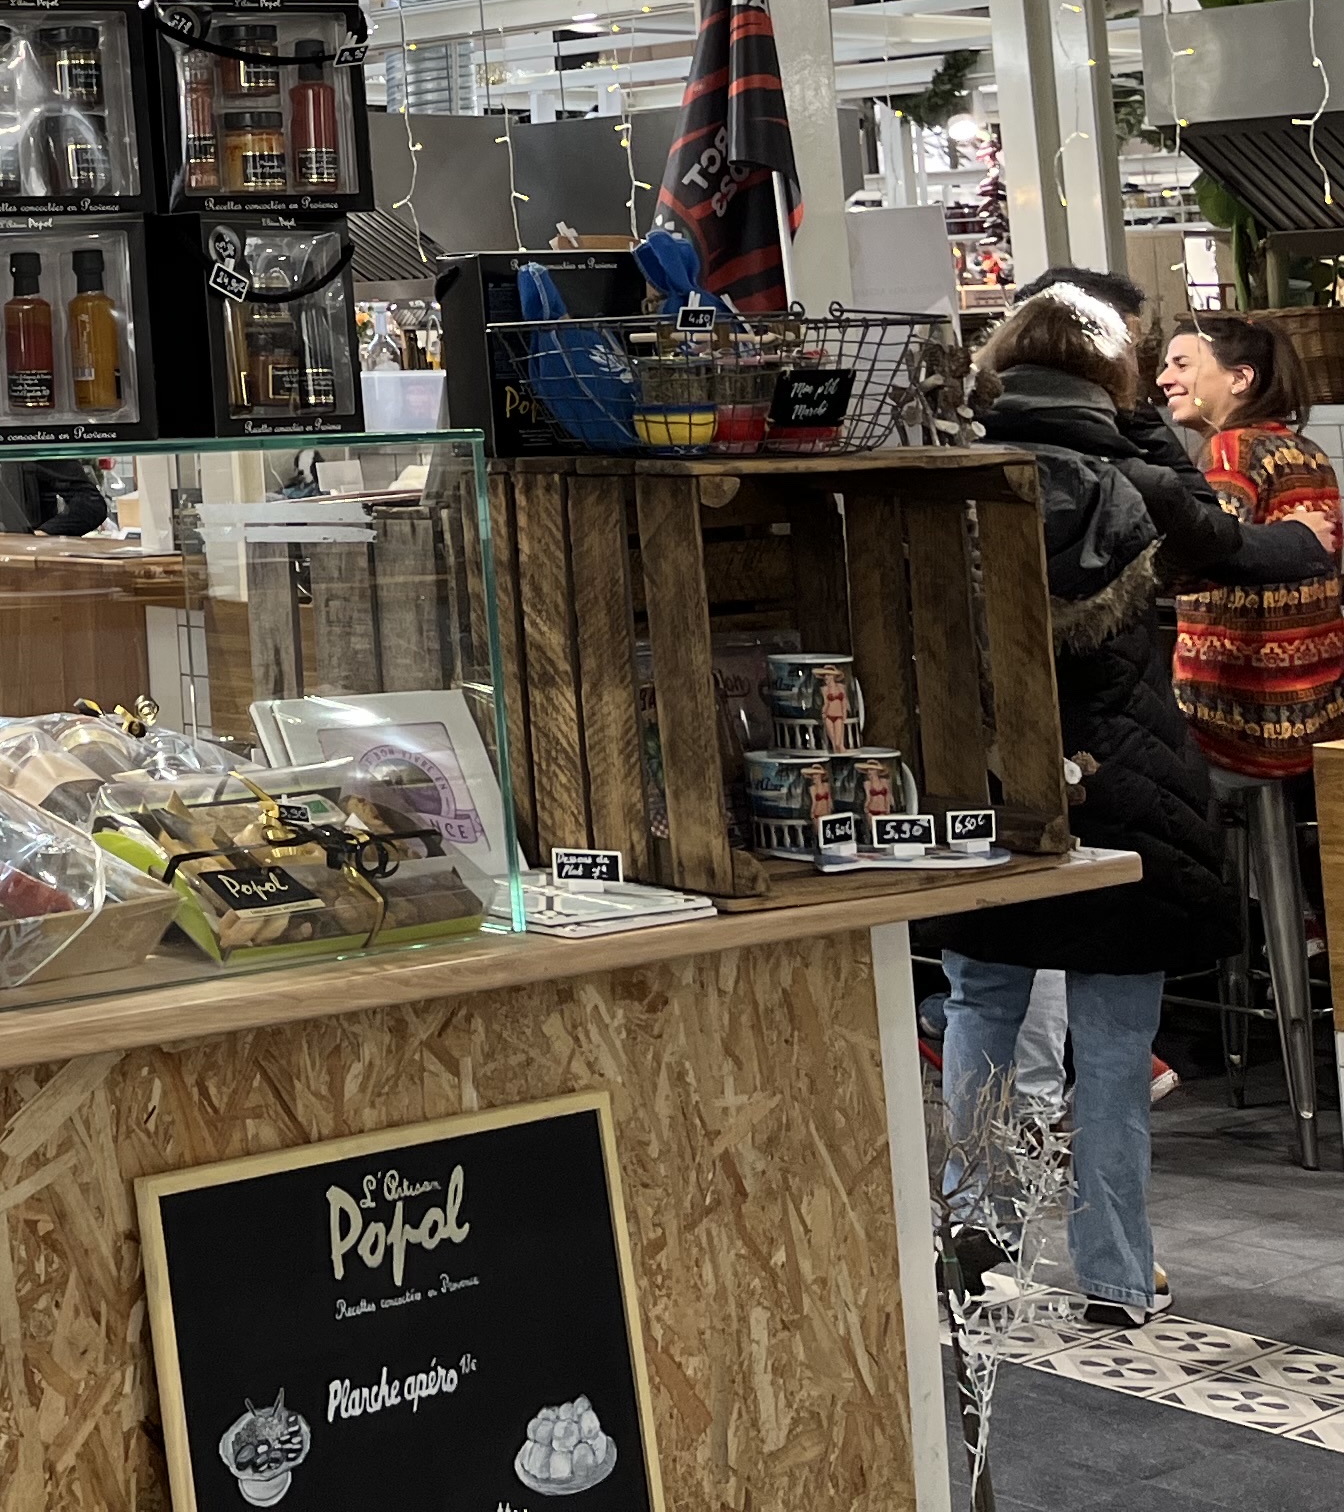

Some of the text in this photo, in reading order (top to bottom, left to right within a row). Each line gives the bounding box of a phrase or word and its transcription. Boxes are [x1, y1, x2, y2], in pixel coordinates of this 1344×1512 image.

[80, 198, 120, 212] Provence
[301, 196, 338, 210] Provence
[27, 218, 53, 230] Popol
[73, 426, 117, 440] Provence
[217, 872, 289, 901] Popol
[326, 1164, 470, 1287] Popol
[335, 1299, 376, 1320] Recettes
[428, 1289, 437, 1297] en
[327, 1366, 401, 1423] Planche
[404, 1357, 458, 1413] apéro
